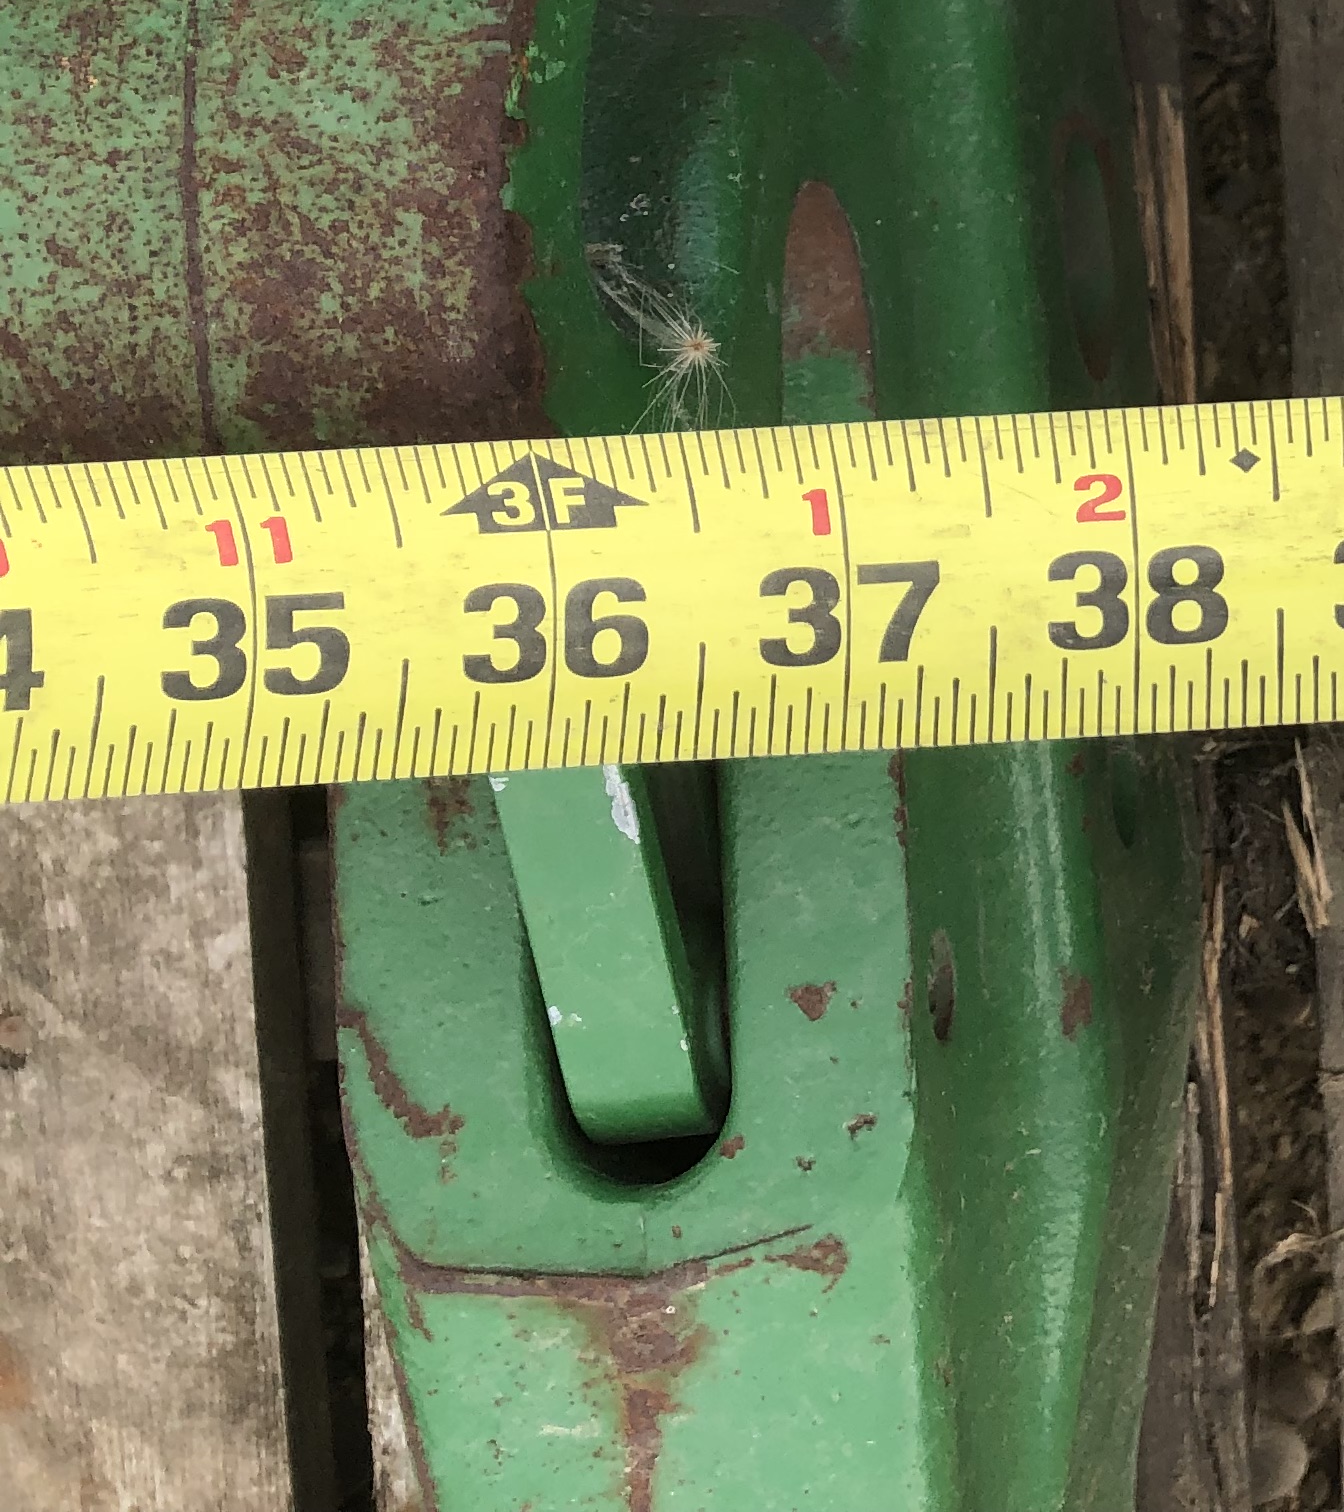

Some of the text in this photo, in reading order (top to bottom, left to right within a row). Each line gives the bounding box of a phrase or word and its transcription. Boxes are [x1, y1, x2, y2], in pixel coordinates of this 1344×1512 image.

[492, 477, 585, 527] 3F
[802, 489, 831, 535] 1
[1073, 474, 1126, 523] 2
[205, 517, 293, 566] 11
[160, 592, 350, 700] 35
[463, 577, 649, 684] 36
[759, 560, 941, 667] 37
[1048, 545, 1229, 650] 38
